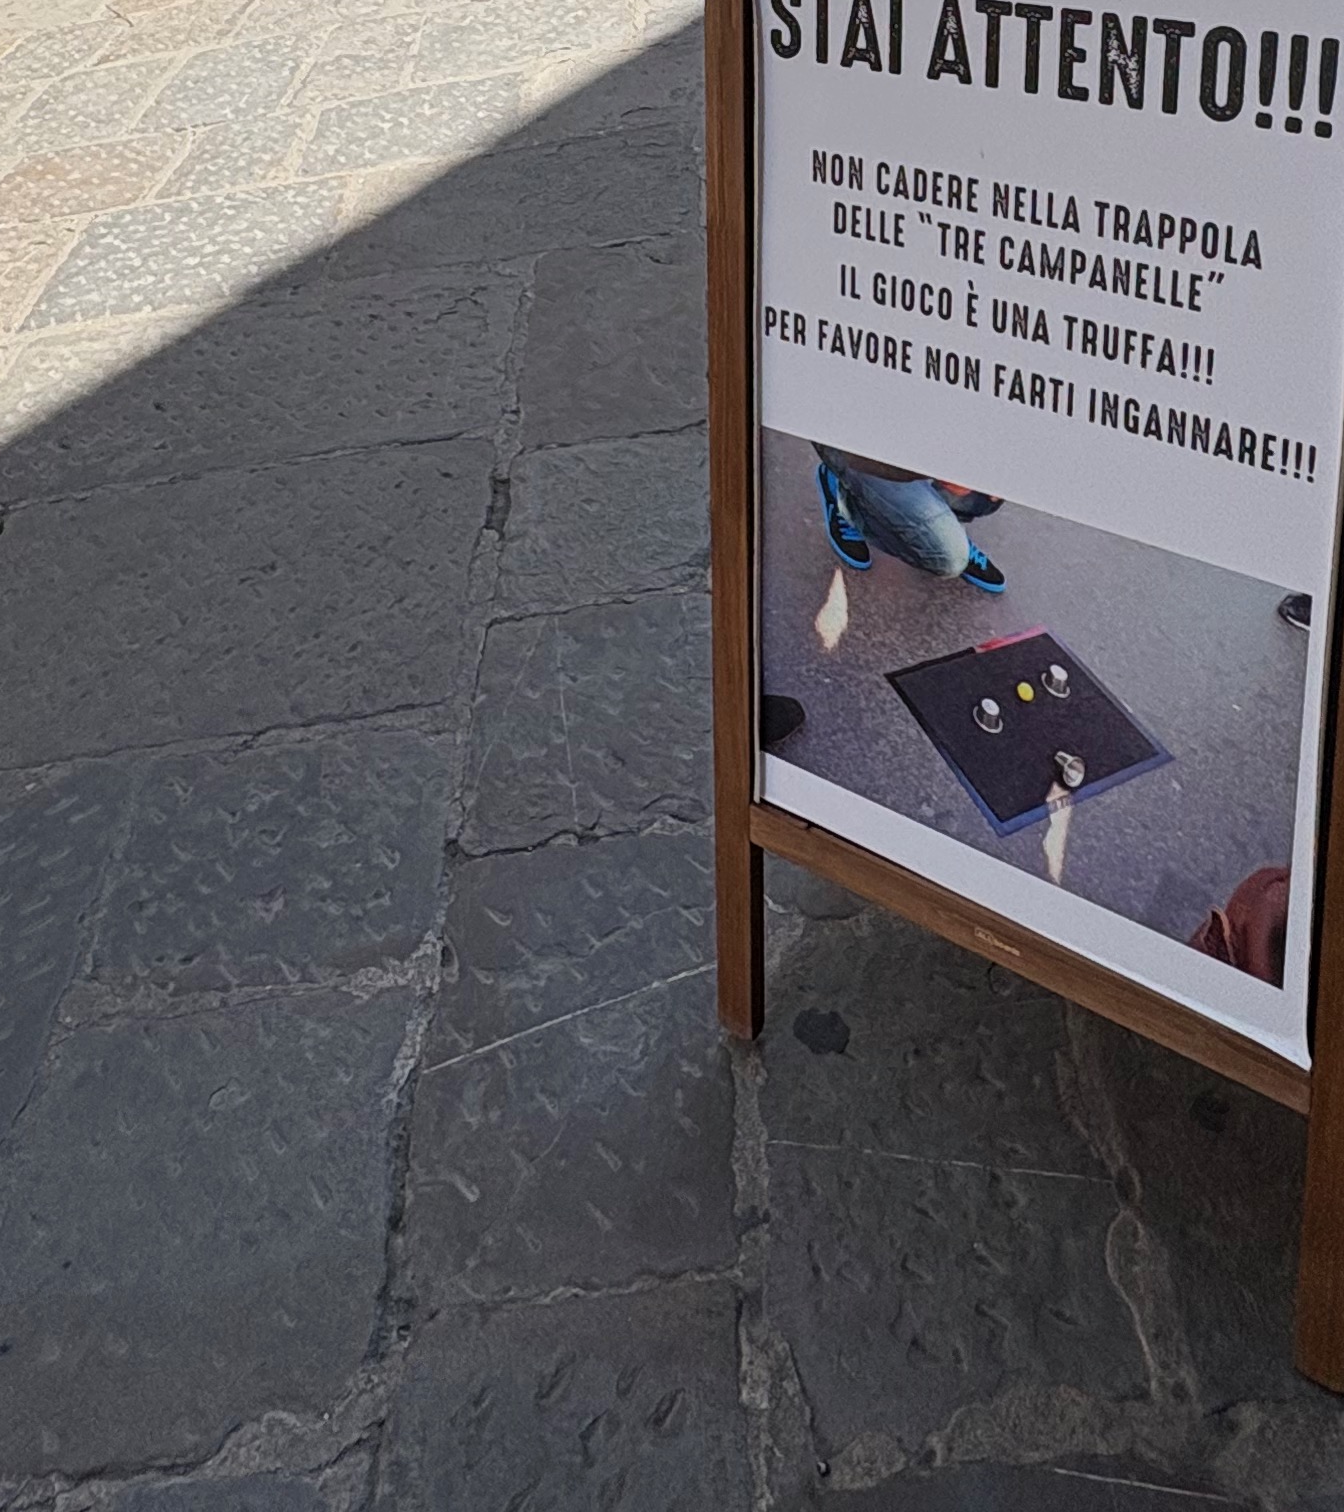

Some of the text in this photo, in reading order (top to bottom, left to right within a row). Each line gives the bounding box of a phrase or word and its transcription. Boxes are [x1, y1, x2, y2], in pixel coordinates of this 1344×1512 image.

[812, 149, 1263, 270] NON CADERE NELLA TRAPPOLA
[833, 202, 906, 248] DELLE
[840, 265, 1216, 385] IL GIOCO È UNA TRUFFA!!!
[764, 307, 1317, 483] PER FAVORE NON FARTI INGANNARE!!!
